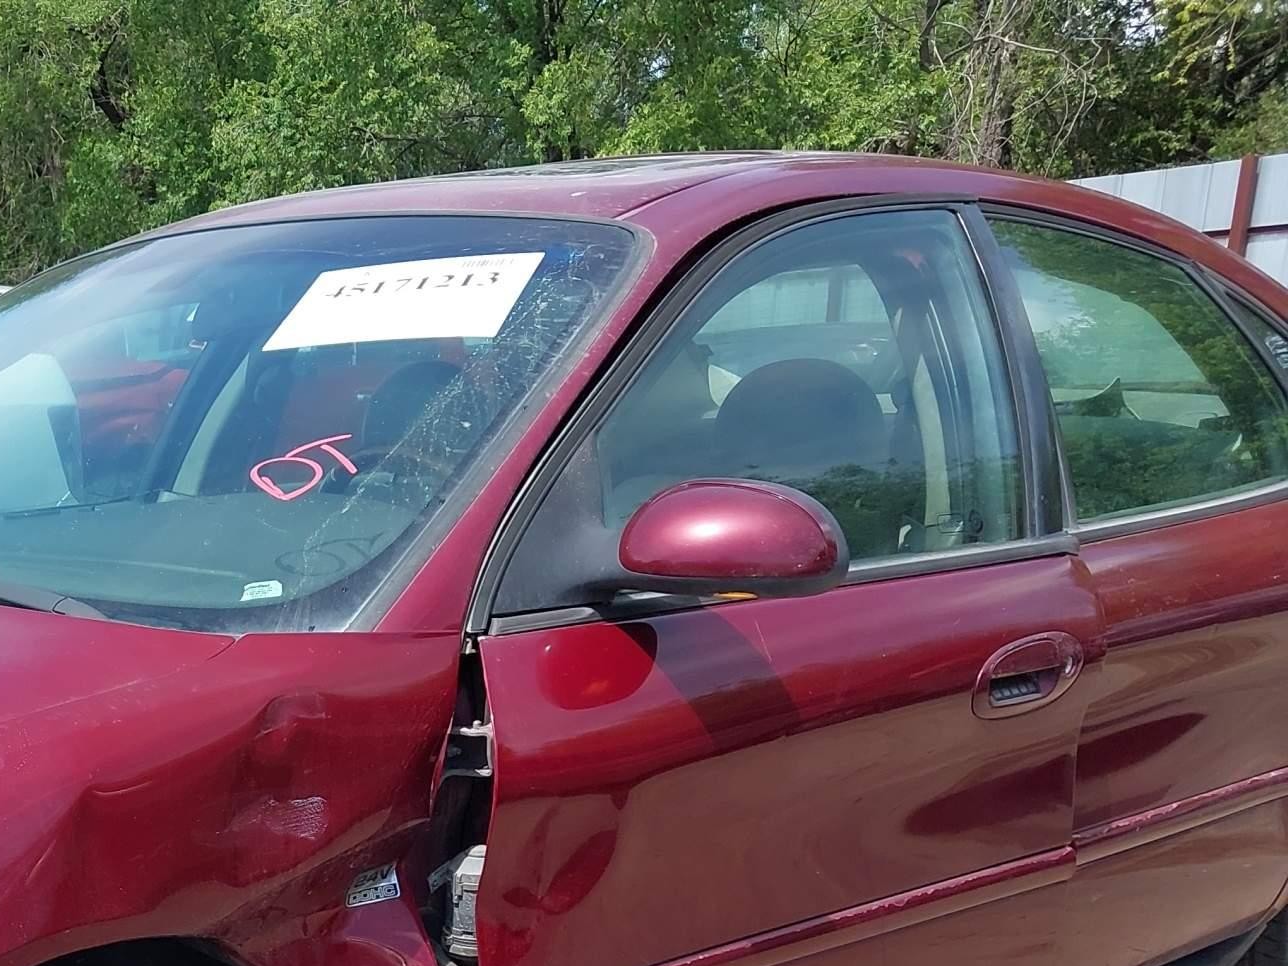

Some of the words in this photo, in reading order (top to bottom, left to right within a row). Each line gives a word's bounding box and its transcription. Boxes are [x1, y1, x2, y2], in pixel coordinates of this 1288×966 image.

[325, 271, 500, 298] 45171213
[354, 864, 394, 887] 24V
[348, 884, 397, 905] DOHC
